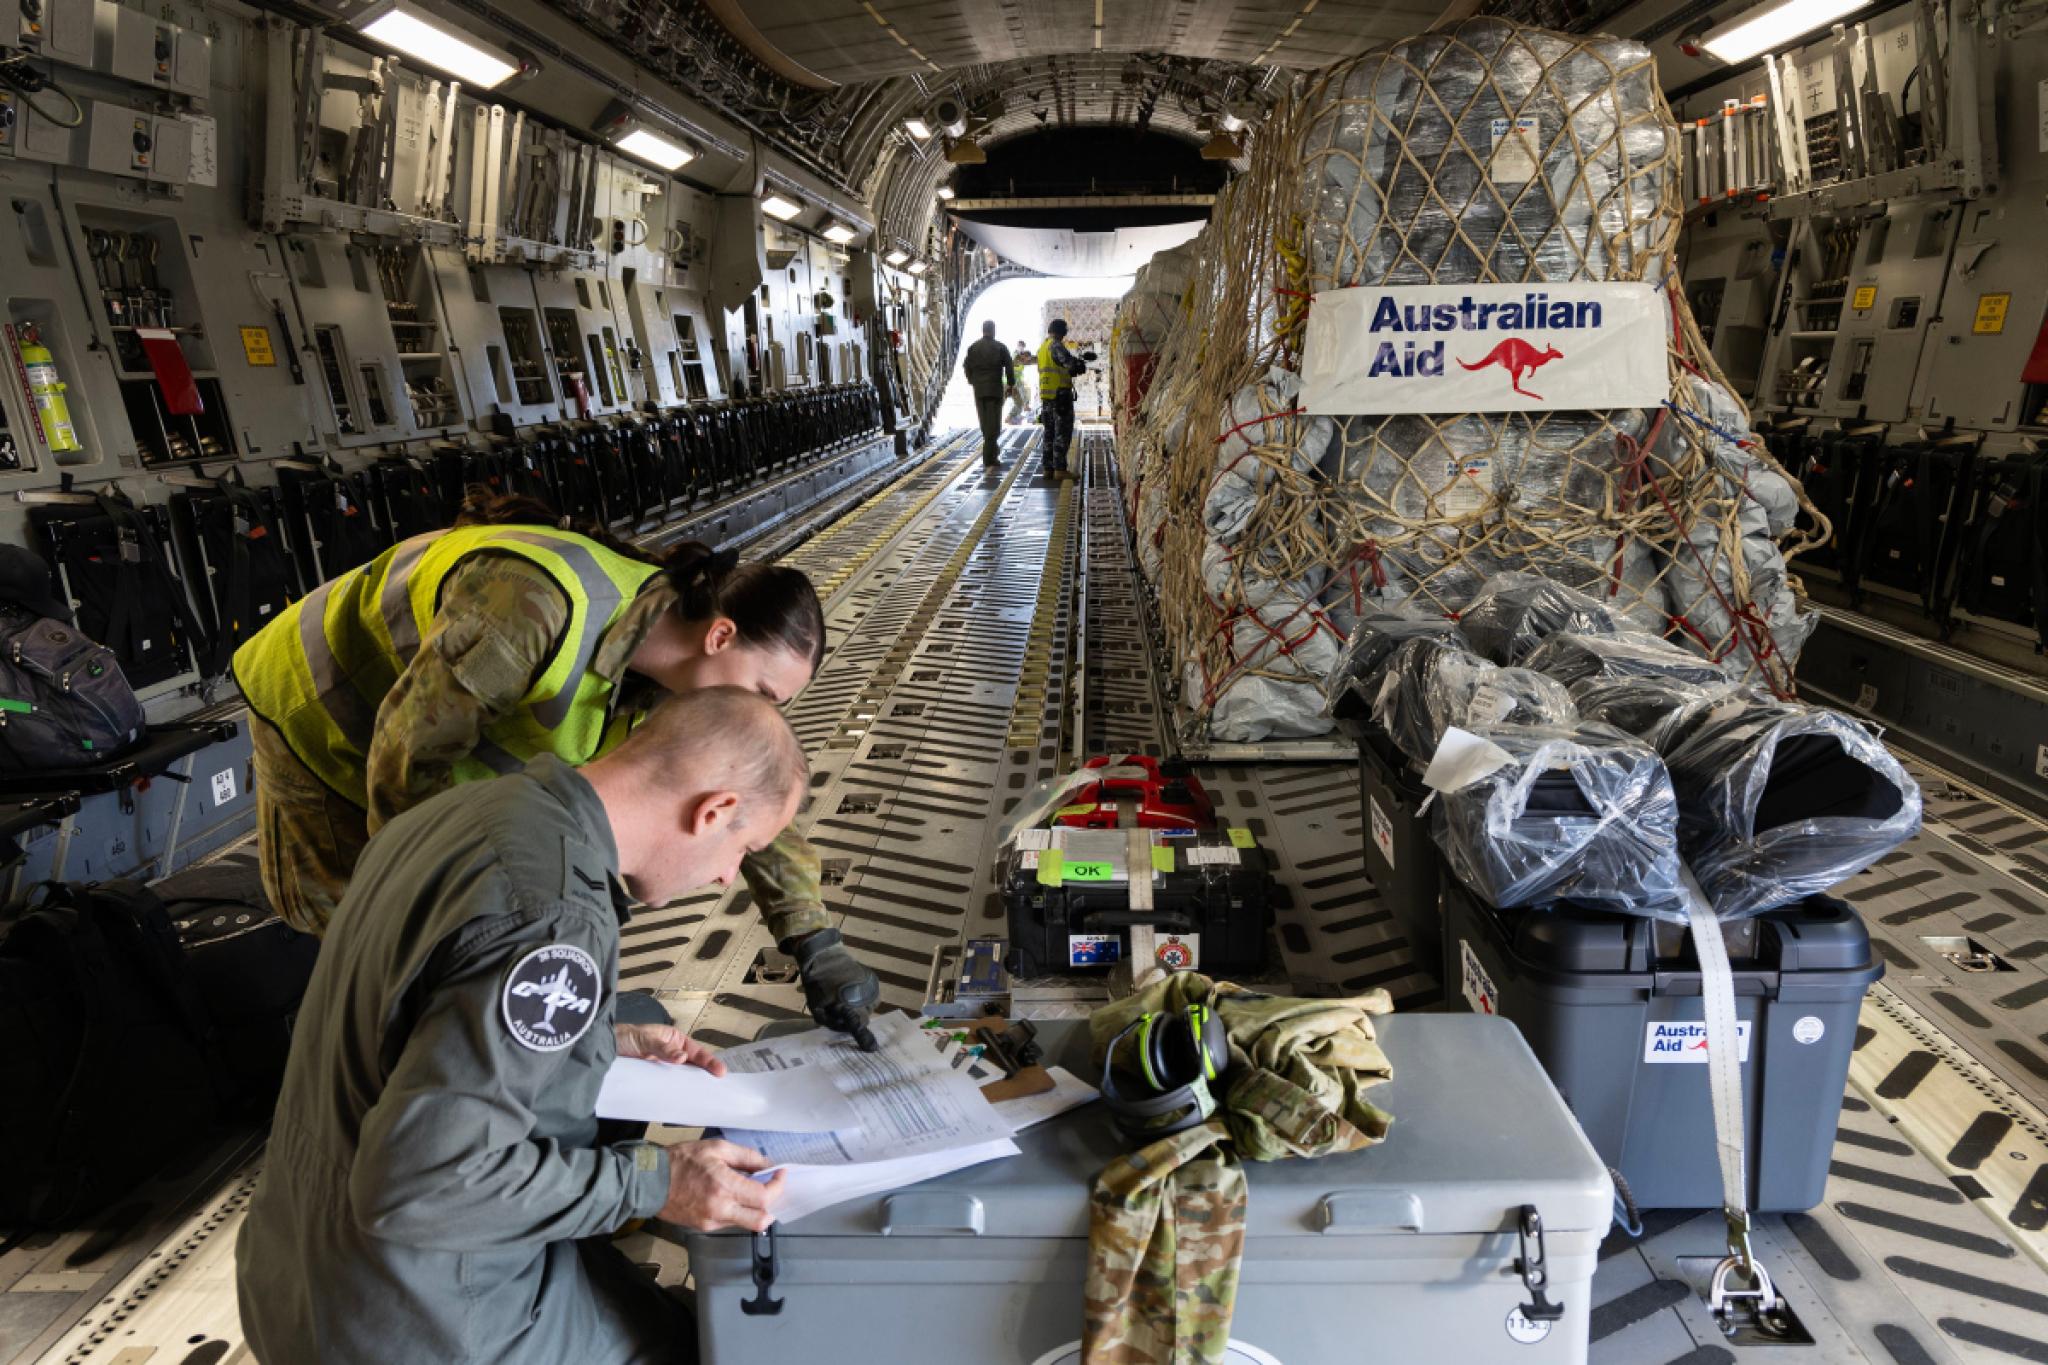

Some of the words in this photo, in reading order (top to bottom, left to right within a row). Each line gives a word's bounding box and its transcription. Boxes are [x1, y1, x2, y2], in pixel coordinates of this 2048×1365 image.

[1369, 293, 1602, 333] Australian
[1368, 340, 1445, 378] Aid
[1074, 866, 1101, 876] OK
[513, 1020, 572, 1046] AUSTRALIA
[1654, 1025, 1744, 1036] Austrn
[1653, 1039, 1682, 1052] Aid
